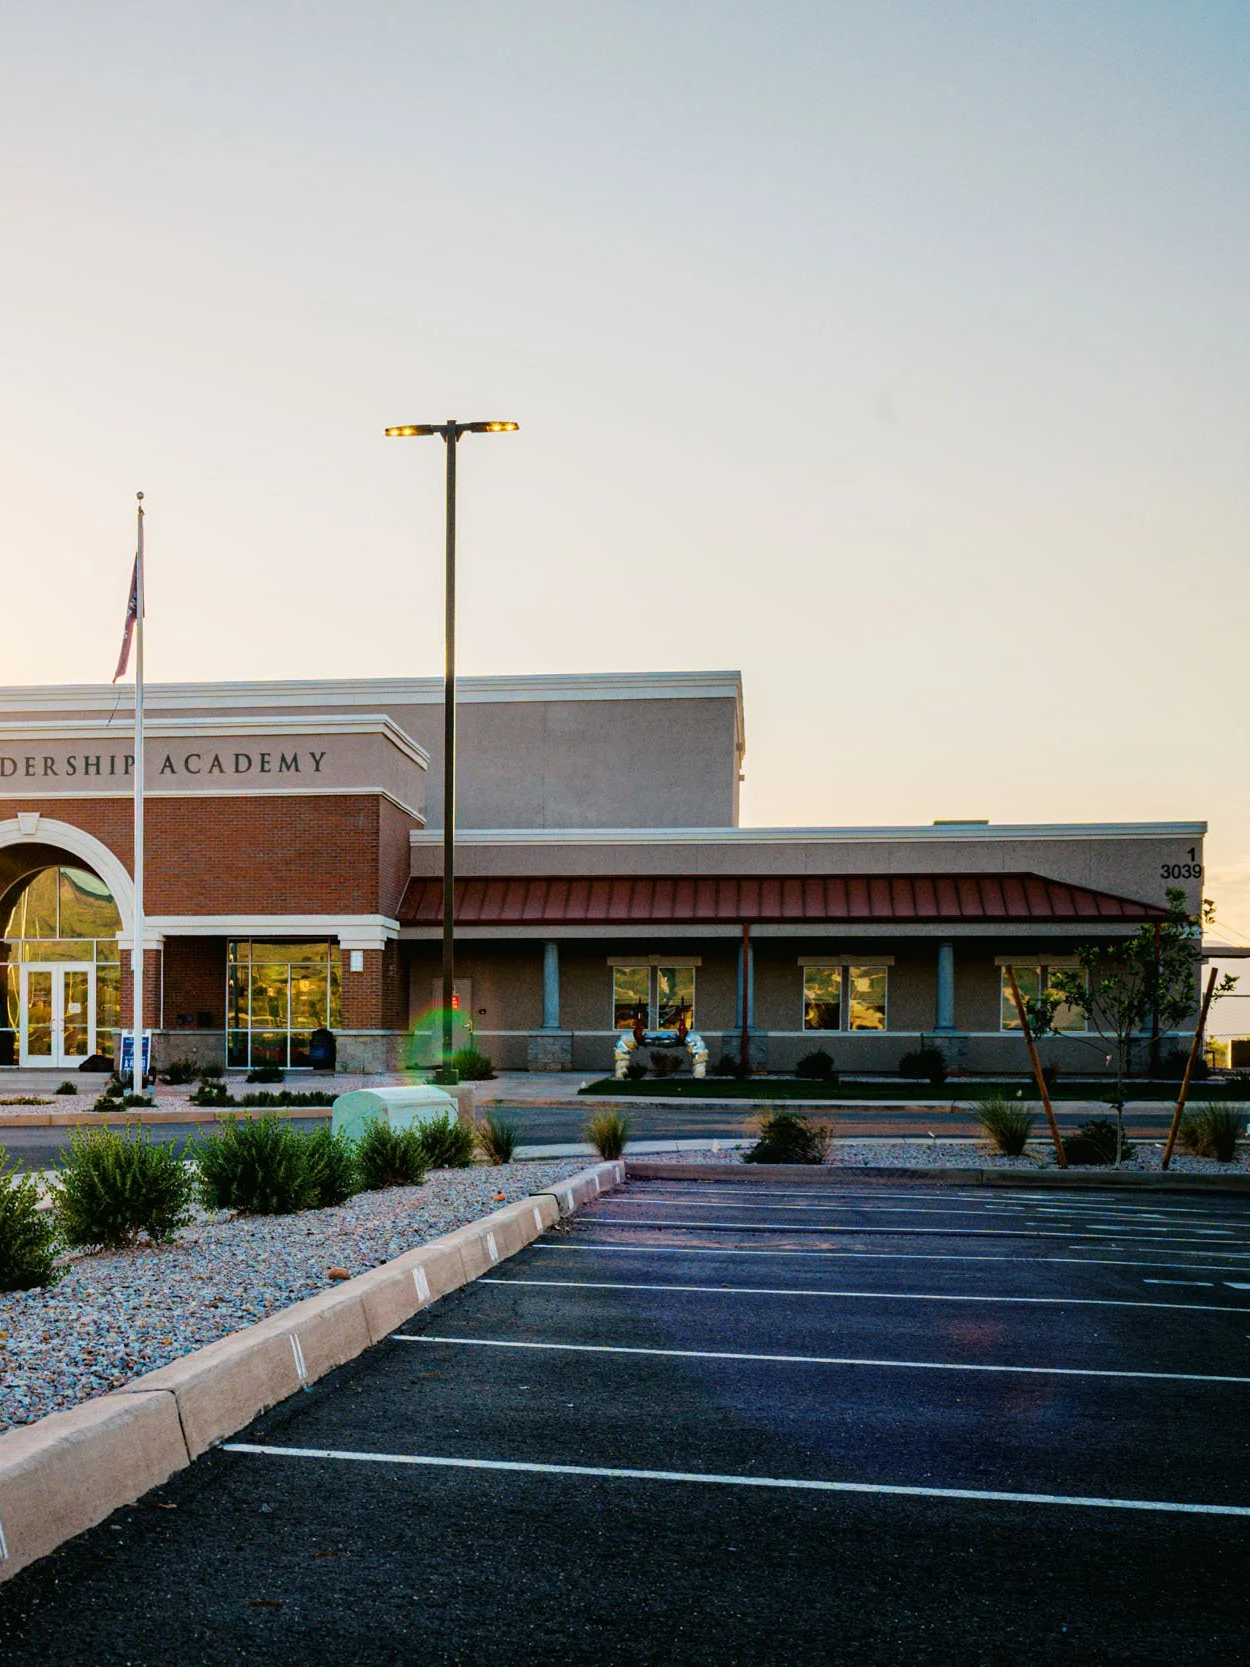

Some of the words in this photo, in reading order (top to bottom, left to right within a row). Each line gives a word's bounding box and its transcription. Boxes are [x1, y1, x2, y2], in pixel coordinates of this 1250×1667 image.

[159, 752, 327, 775] ACADEMY
[1187, 847, 1196, 862] 1
[1160, 864, 1202, 879] 3039
